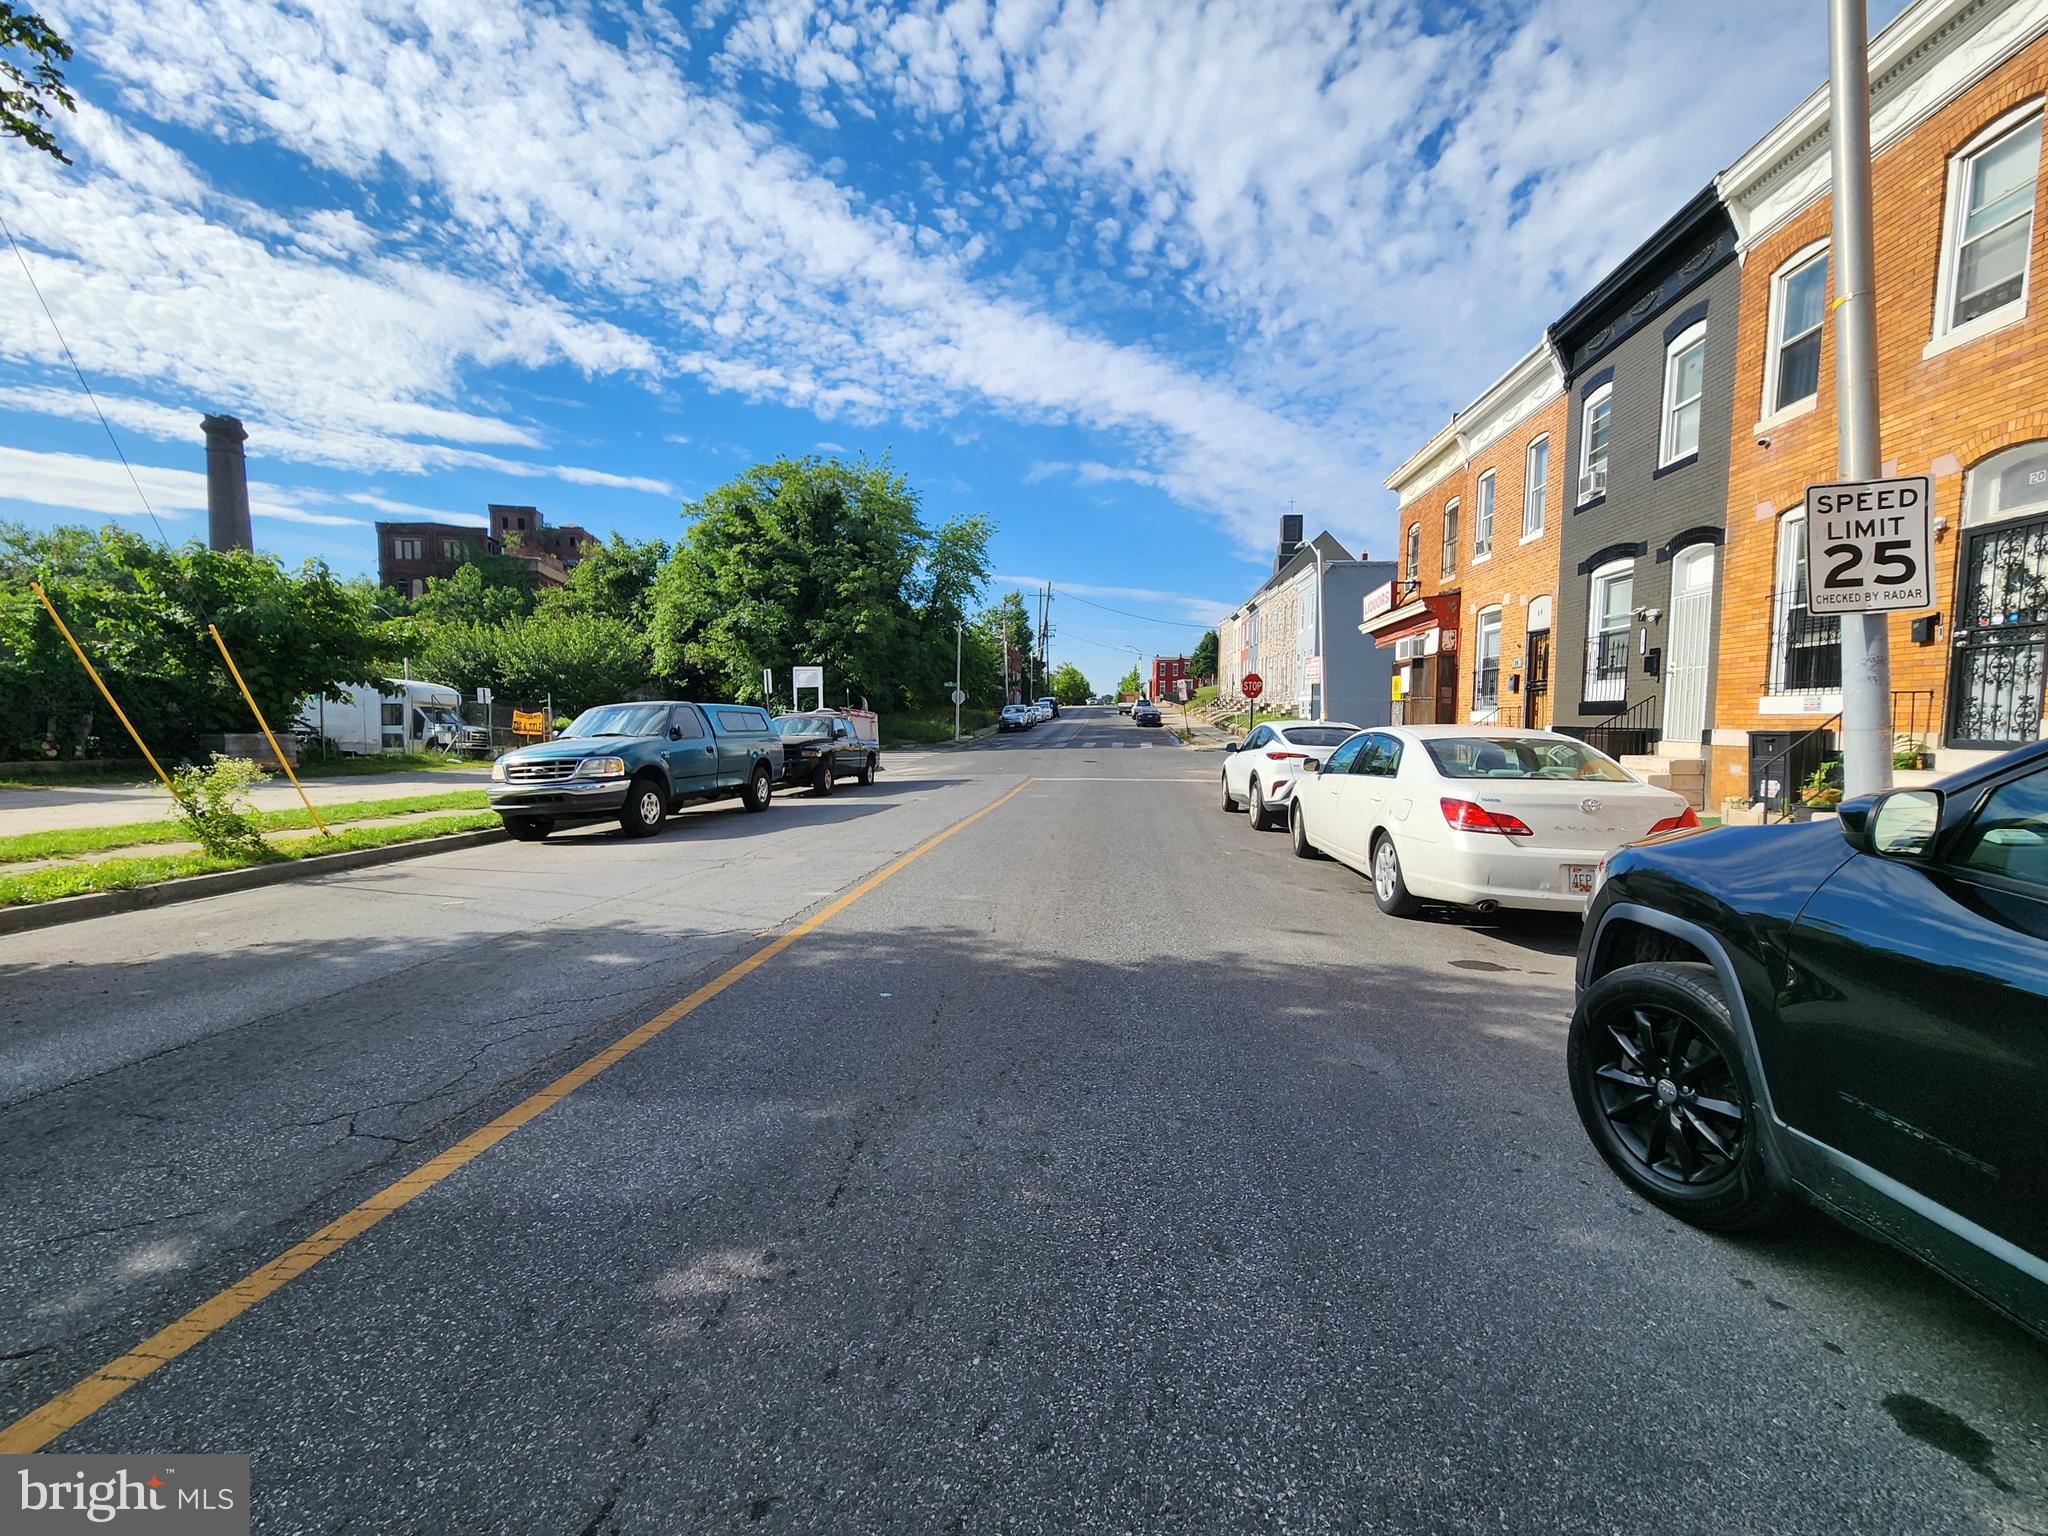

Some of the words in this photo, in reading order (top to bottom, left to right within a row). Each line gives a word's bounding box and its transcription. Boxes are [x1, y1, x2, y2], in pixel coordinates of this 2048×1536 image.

[2031, 471, 2045, 483] 20
[1817, 488, 1918, 514] SPEED
[1828, 516, 1905, 540] LIMIT
[1823, 539, 1917, 589] 25
[1364, 592, 1390, 614] LIQUORS
[1816, 592, 1861, 605] CHECKED
[1865, 591, 1879, 602] BY
[1883, 588, 1922, 600] RADAR
[1243, 681, 1263, 691] STOP
